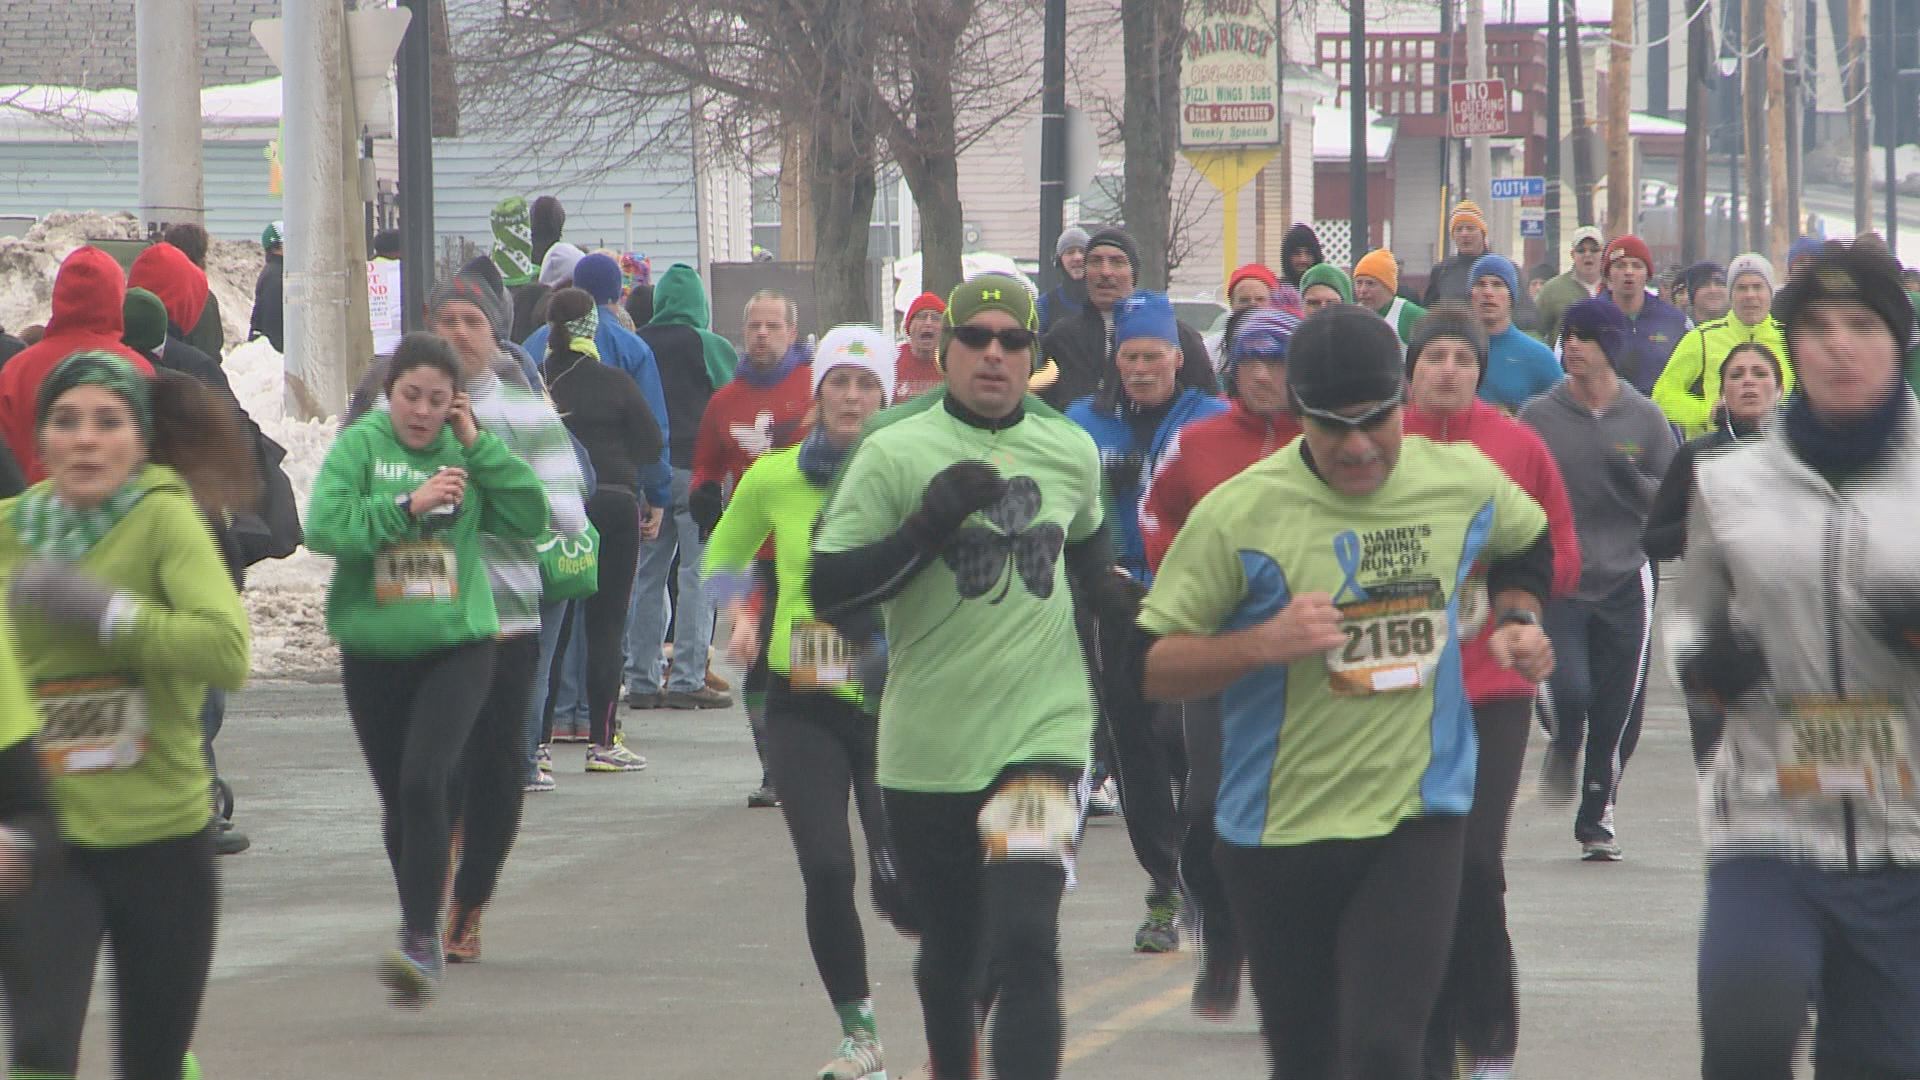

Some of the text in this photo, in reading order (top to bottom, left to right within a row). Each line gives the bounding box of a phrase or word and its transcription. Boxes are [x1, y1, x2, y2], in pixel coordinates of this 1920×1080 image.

[1185, 23, 1273, 60] MARKET
[1185, 85, 1272, 102] PIZZA WINGS SUBS
[1465, 83, 1489, 100] NO
[1188, 105, 1270, 122] BEER GROCERIES
[1454, 98, 1504, 114] LOITERING
[1461, 111, 1497, 123] POLICE
[1192, 125, 1268, 141] Weekly Specials
[1492, 181, 1530, 195] OUTH
[1362, 524, 1431, 544] HARRY'S
[1364, 539, 1421, 556] SPRING
[1360, 551, 1430, 571] RUN-OFF
[1341, 617, 1434, 662] 2159
